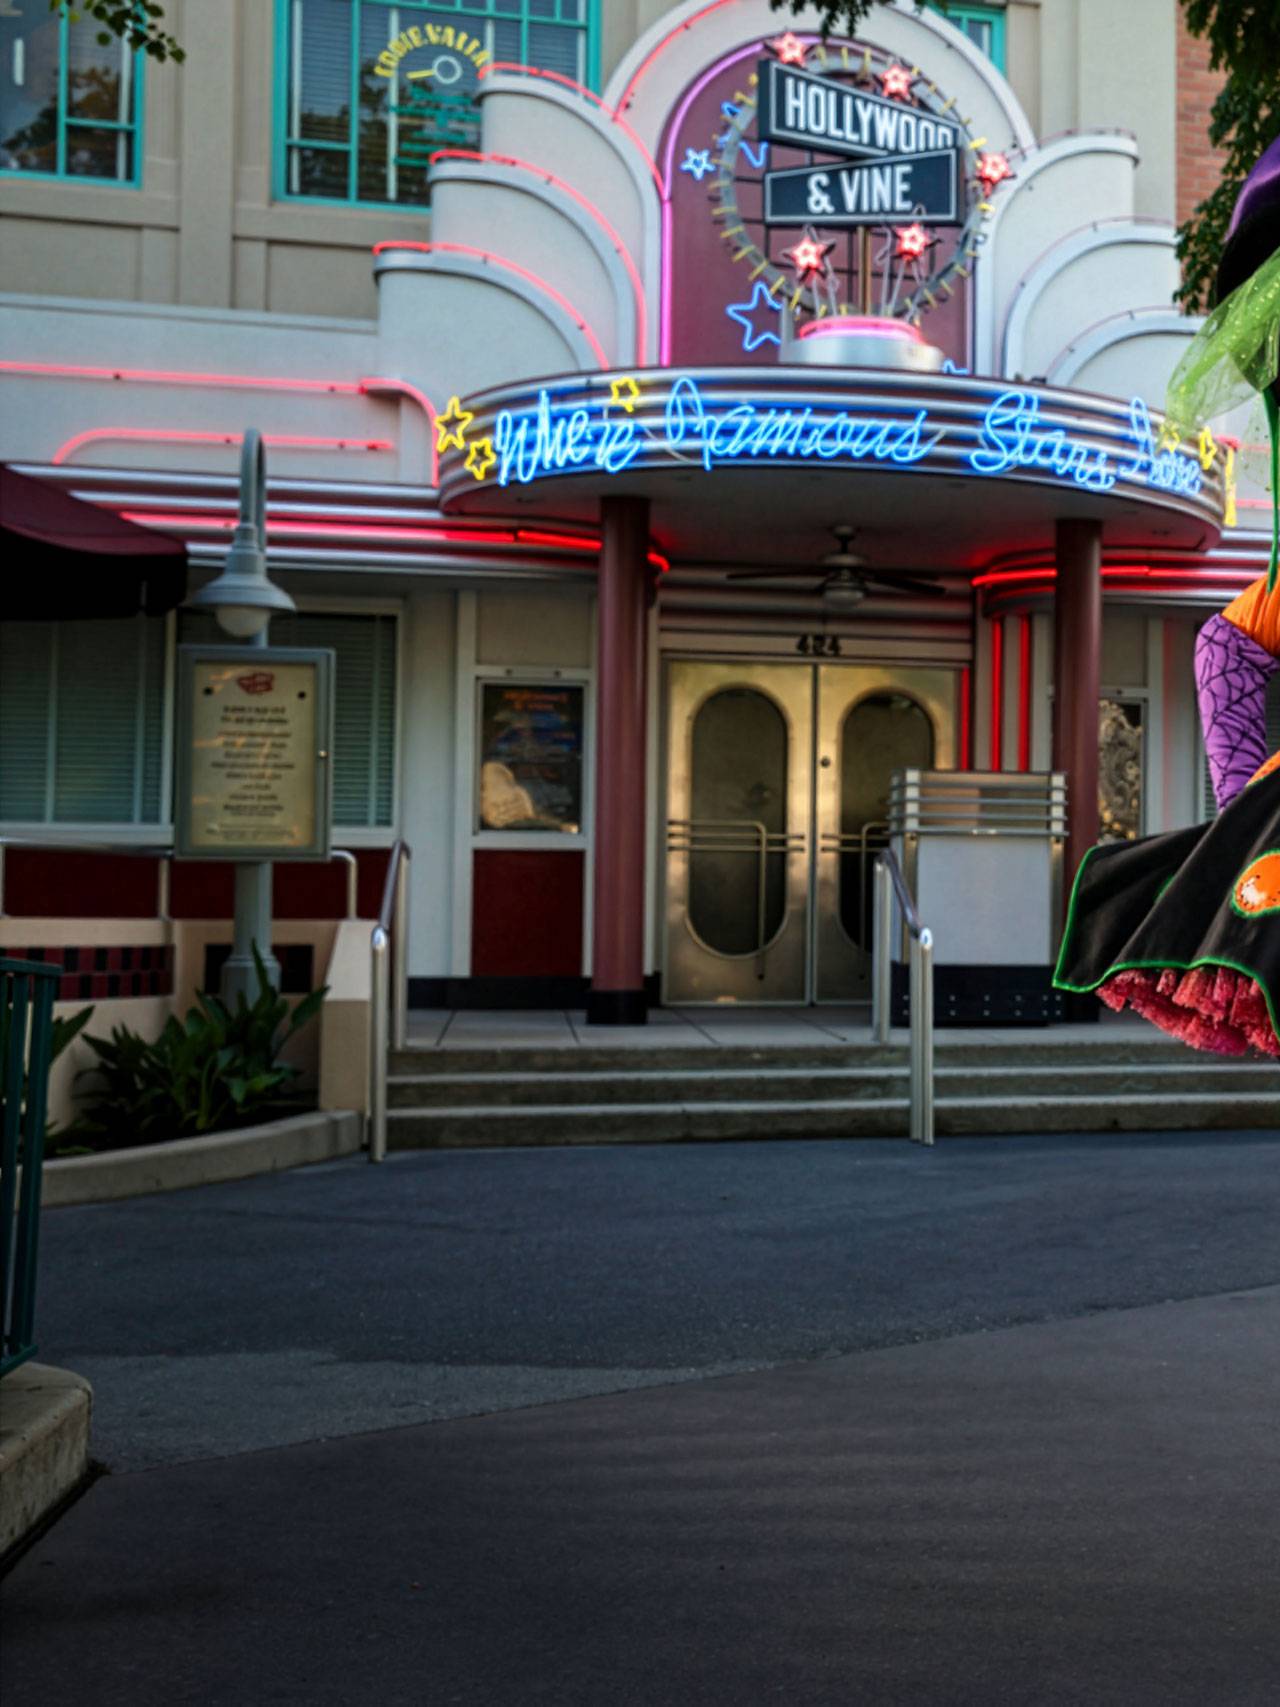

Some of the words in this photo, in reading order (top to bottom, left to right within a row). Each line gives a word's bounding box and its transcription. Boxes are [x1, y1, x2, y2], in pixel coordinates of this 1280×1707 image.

[784, 76, 953, 153] HOLLYWOOD
[806, 171, 835, 215] &
[839, 164, 913, 213] VINE
[496, 389, 640, 486] Where
